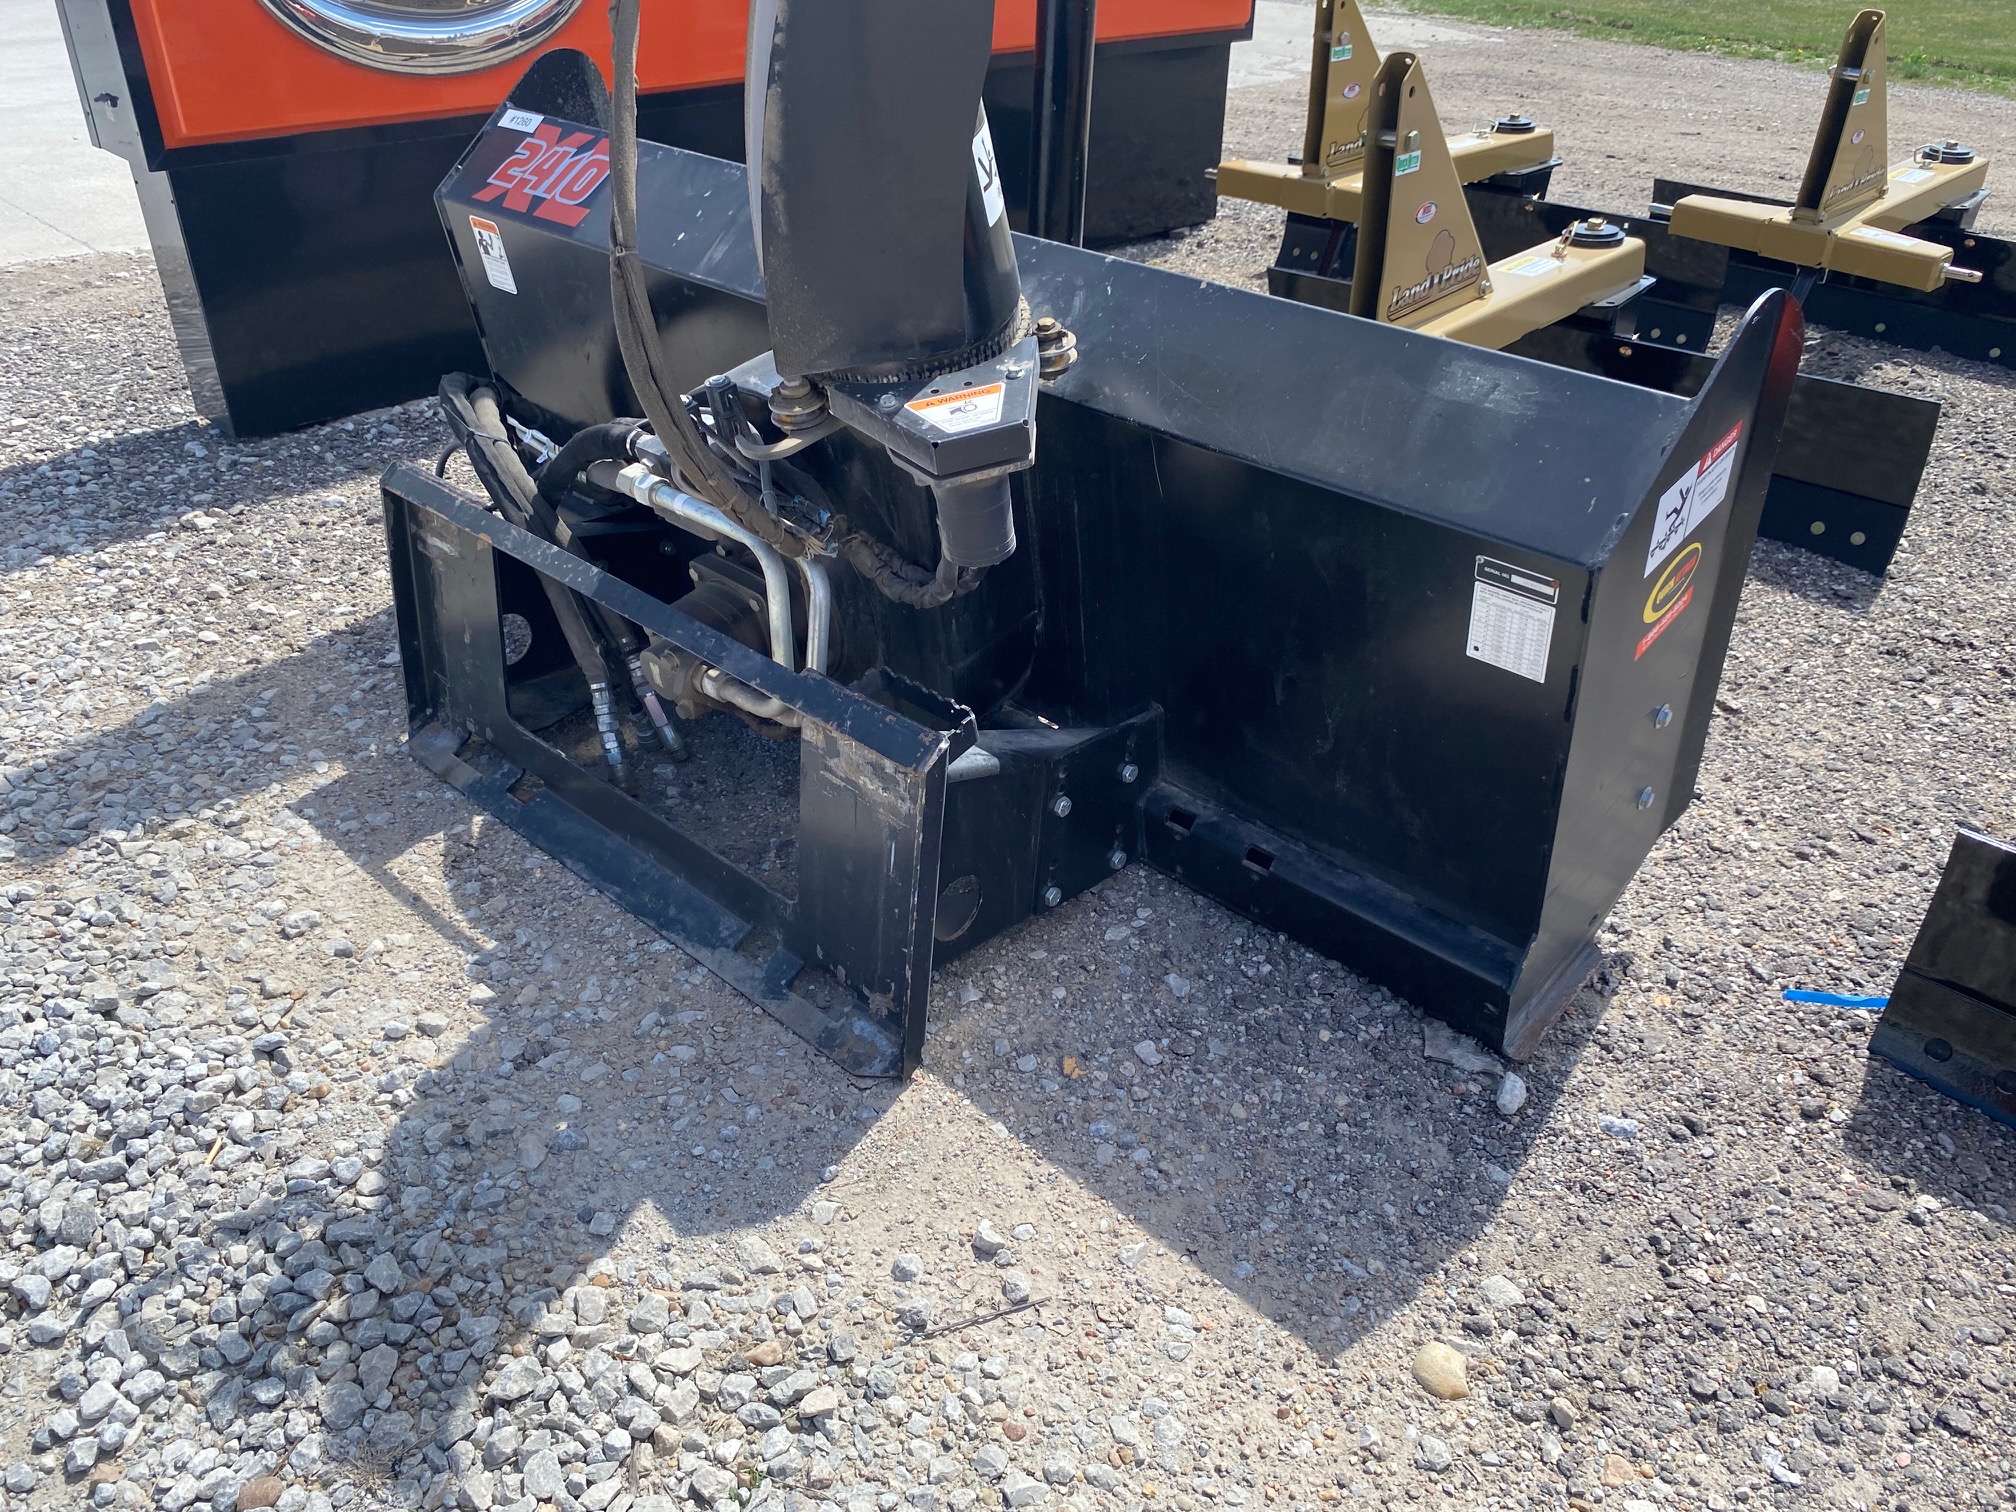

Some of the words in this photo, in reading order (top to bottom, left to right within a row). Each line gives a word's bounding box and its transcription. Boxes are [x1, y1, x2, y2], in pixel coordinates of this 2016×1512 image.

[508, 115, 533, 128] #1260
[486, 137, 611, 206] 2410
[1390, 273, 1433, 312] Land
[1440, 254, 1481, 291] Pride
[937, 388, 991, 404] WARNING
[1712, 428, 1738, 459] DANGER
[1484, 566, 1501, 576] SERIAL
